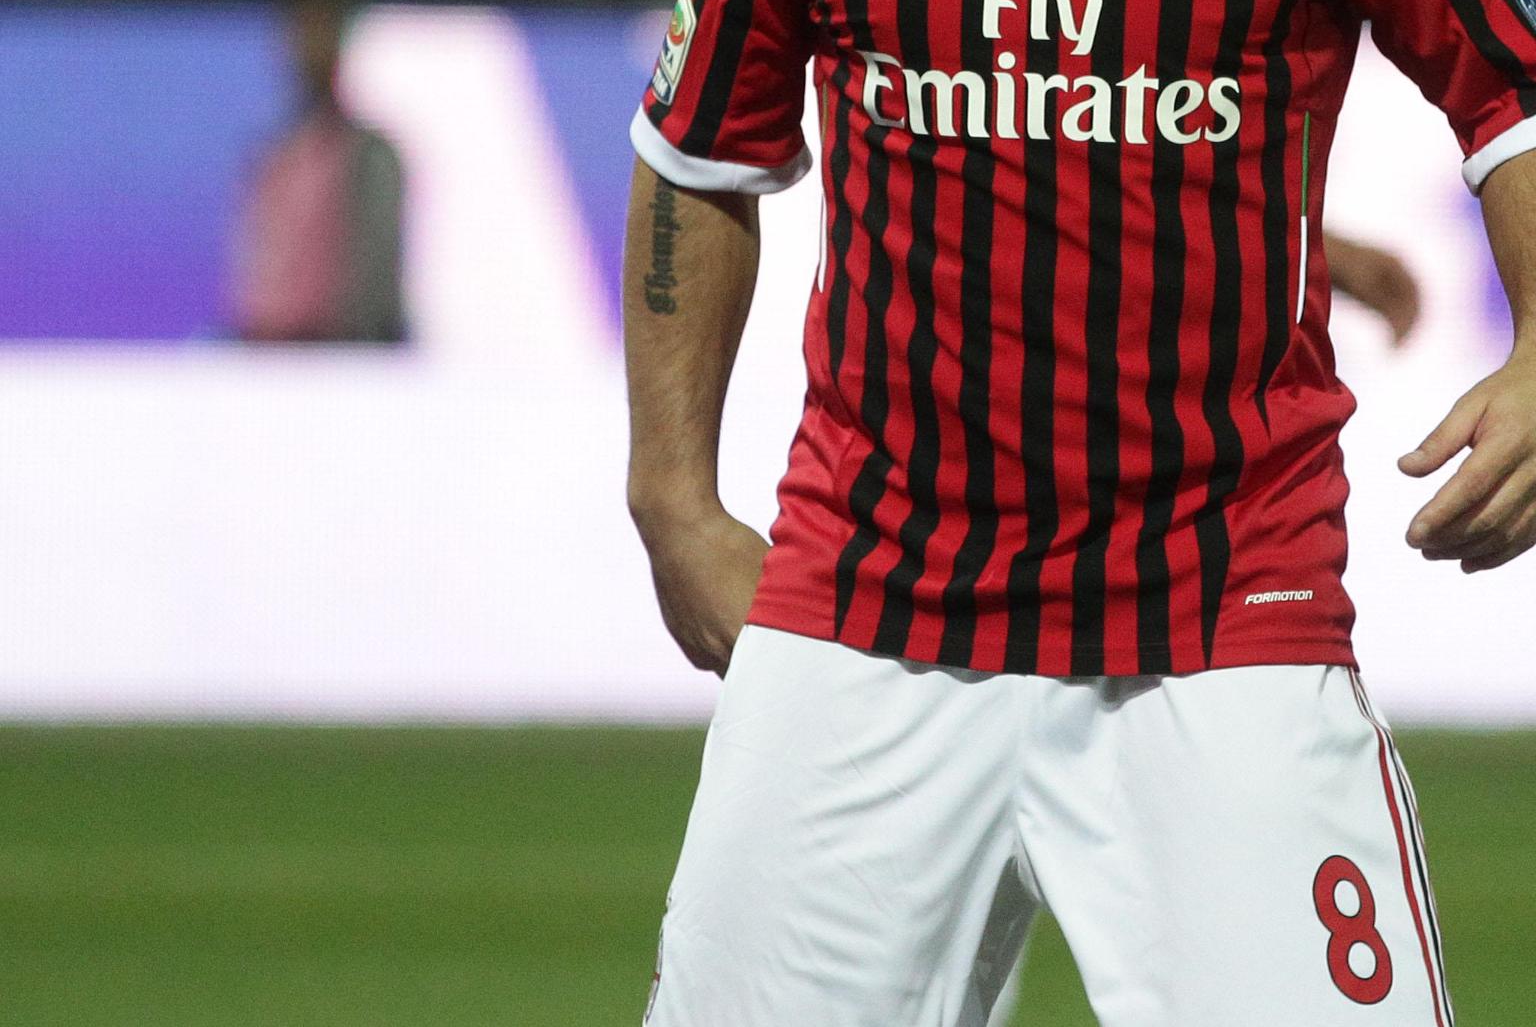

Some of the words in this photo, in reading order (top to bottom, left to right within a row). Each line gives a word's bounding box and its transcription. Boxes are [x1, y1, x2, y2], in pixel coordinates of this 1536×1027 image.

[855, 49, 1242, 145] Emirates
[1244, 589, 1314, 606] FORMOTION
[1312, 854, 1394, 1006] 8
